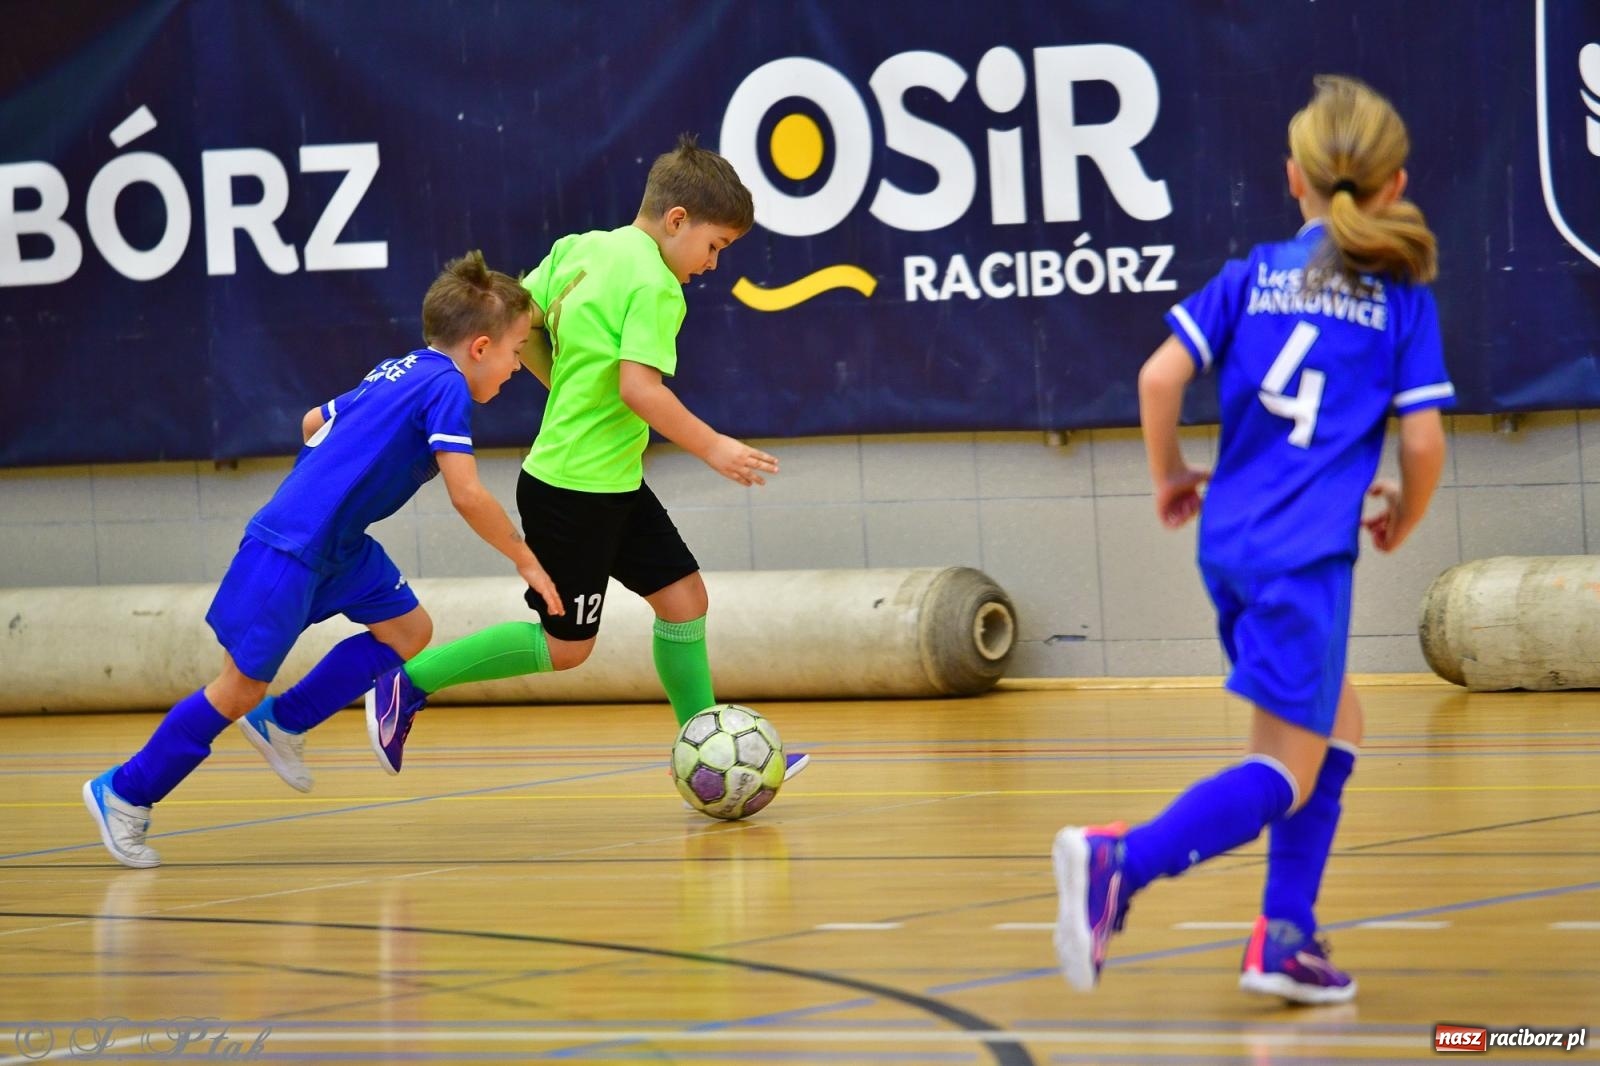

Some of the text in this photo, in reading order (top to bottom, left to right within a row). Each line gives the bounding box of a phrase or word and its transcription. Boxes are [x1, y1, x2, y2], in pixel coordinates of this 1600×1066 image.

[903, 232, 1178, 302] RACIBÓRZ
[1257, 320, 1326, 449] 4
[574, 593, 602, 625] 12
